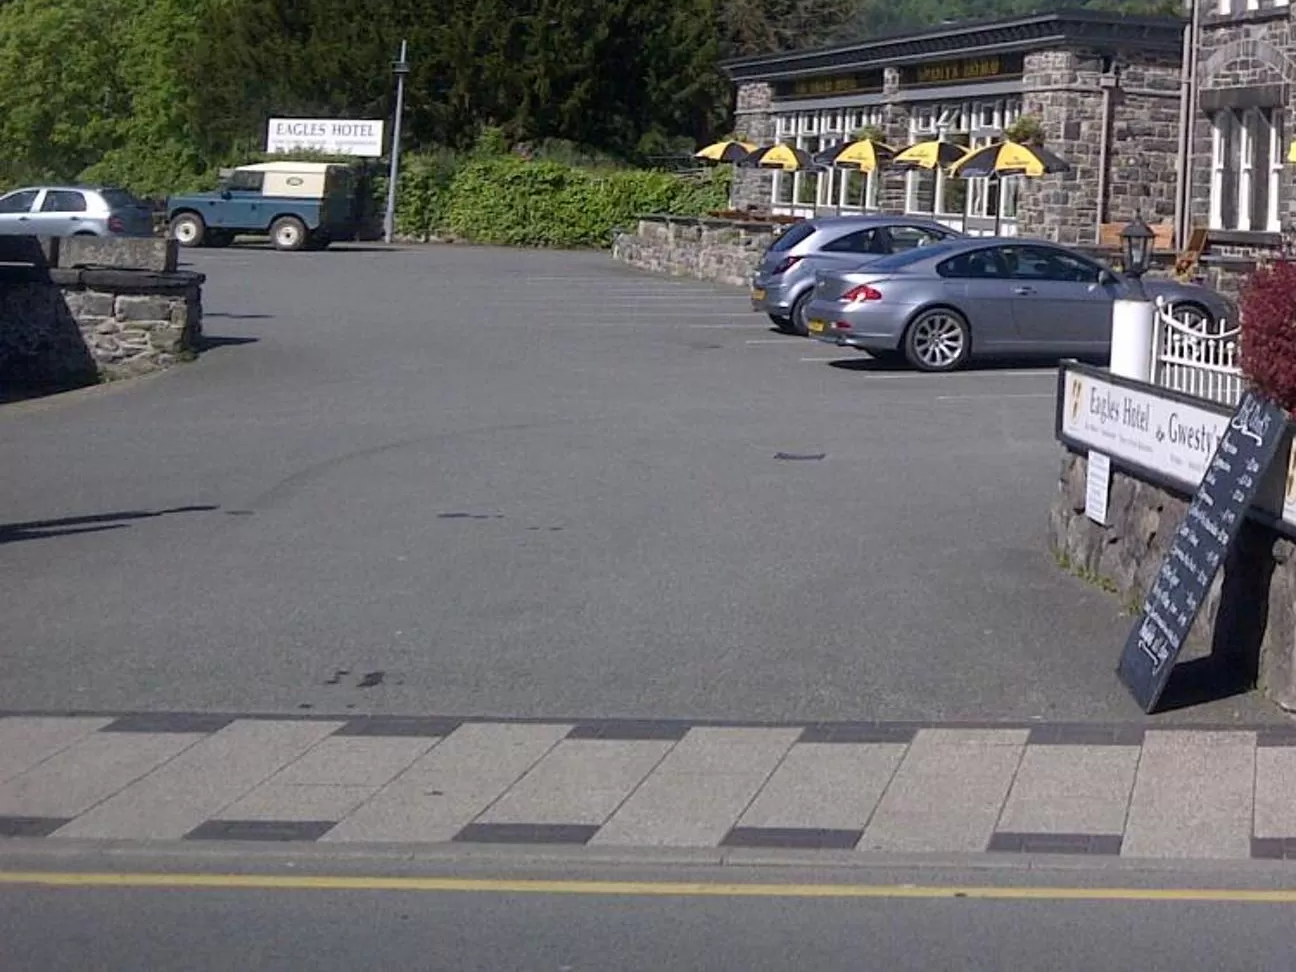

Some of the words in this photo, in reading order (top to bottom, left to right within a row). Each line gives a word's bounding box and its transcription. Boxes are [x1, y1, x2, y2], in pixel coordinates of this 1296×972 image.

[276, 122, 326, 137] EAGLES
[331, 123, 375, 138] HOTEL
[1089, 386, 1120, 425] Eagles
[1122, 396, 1150, 433] Hotel
